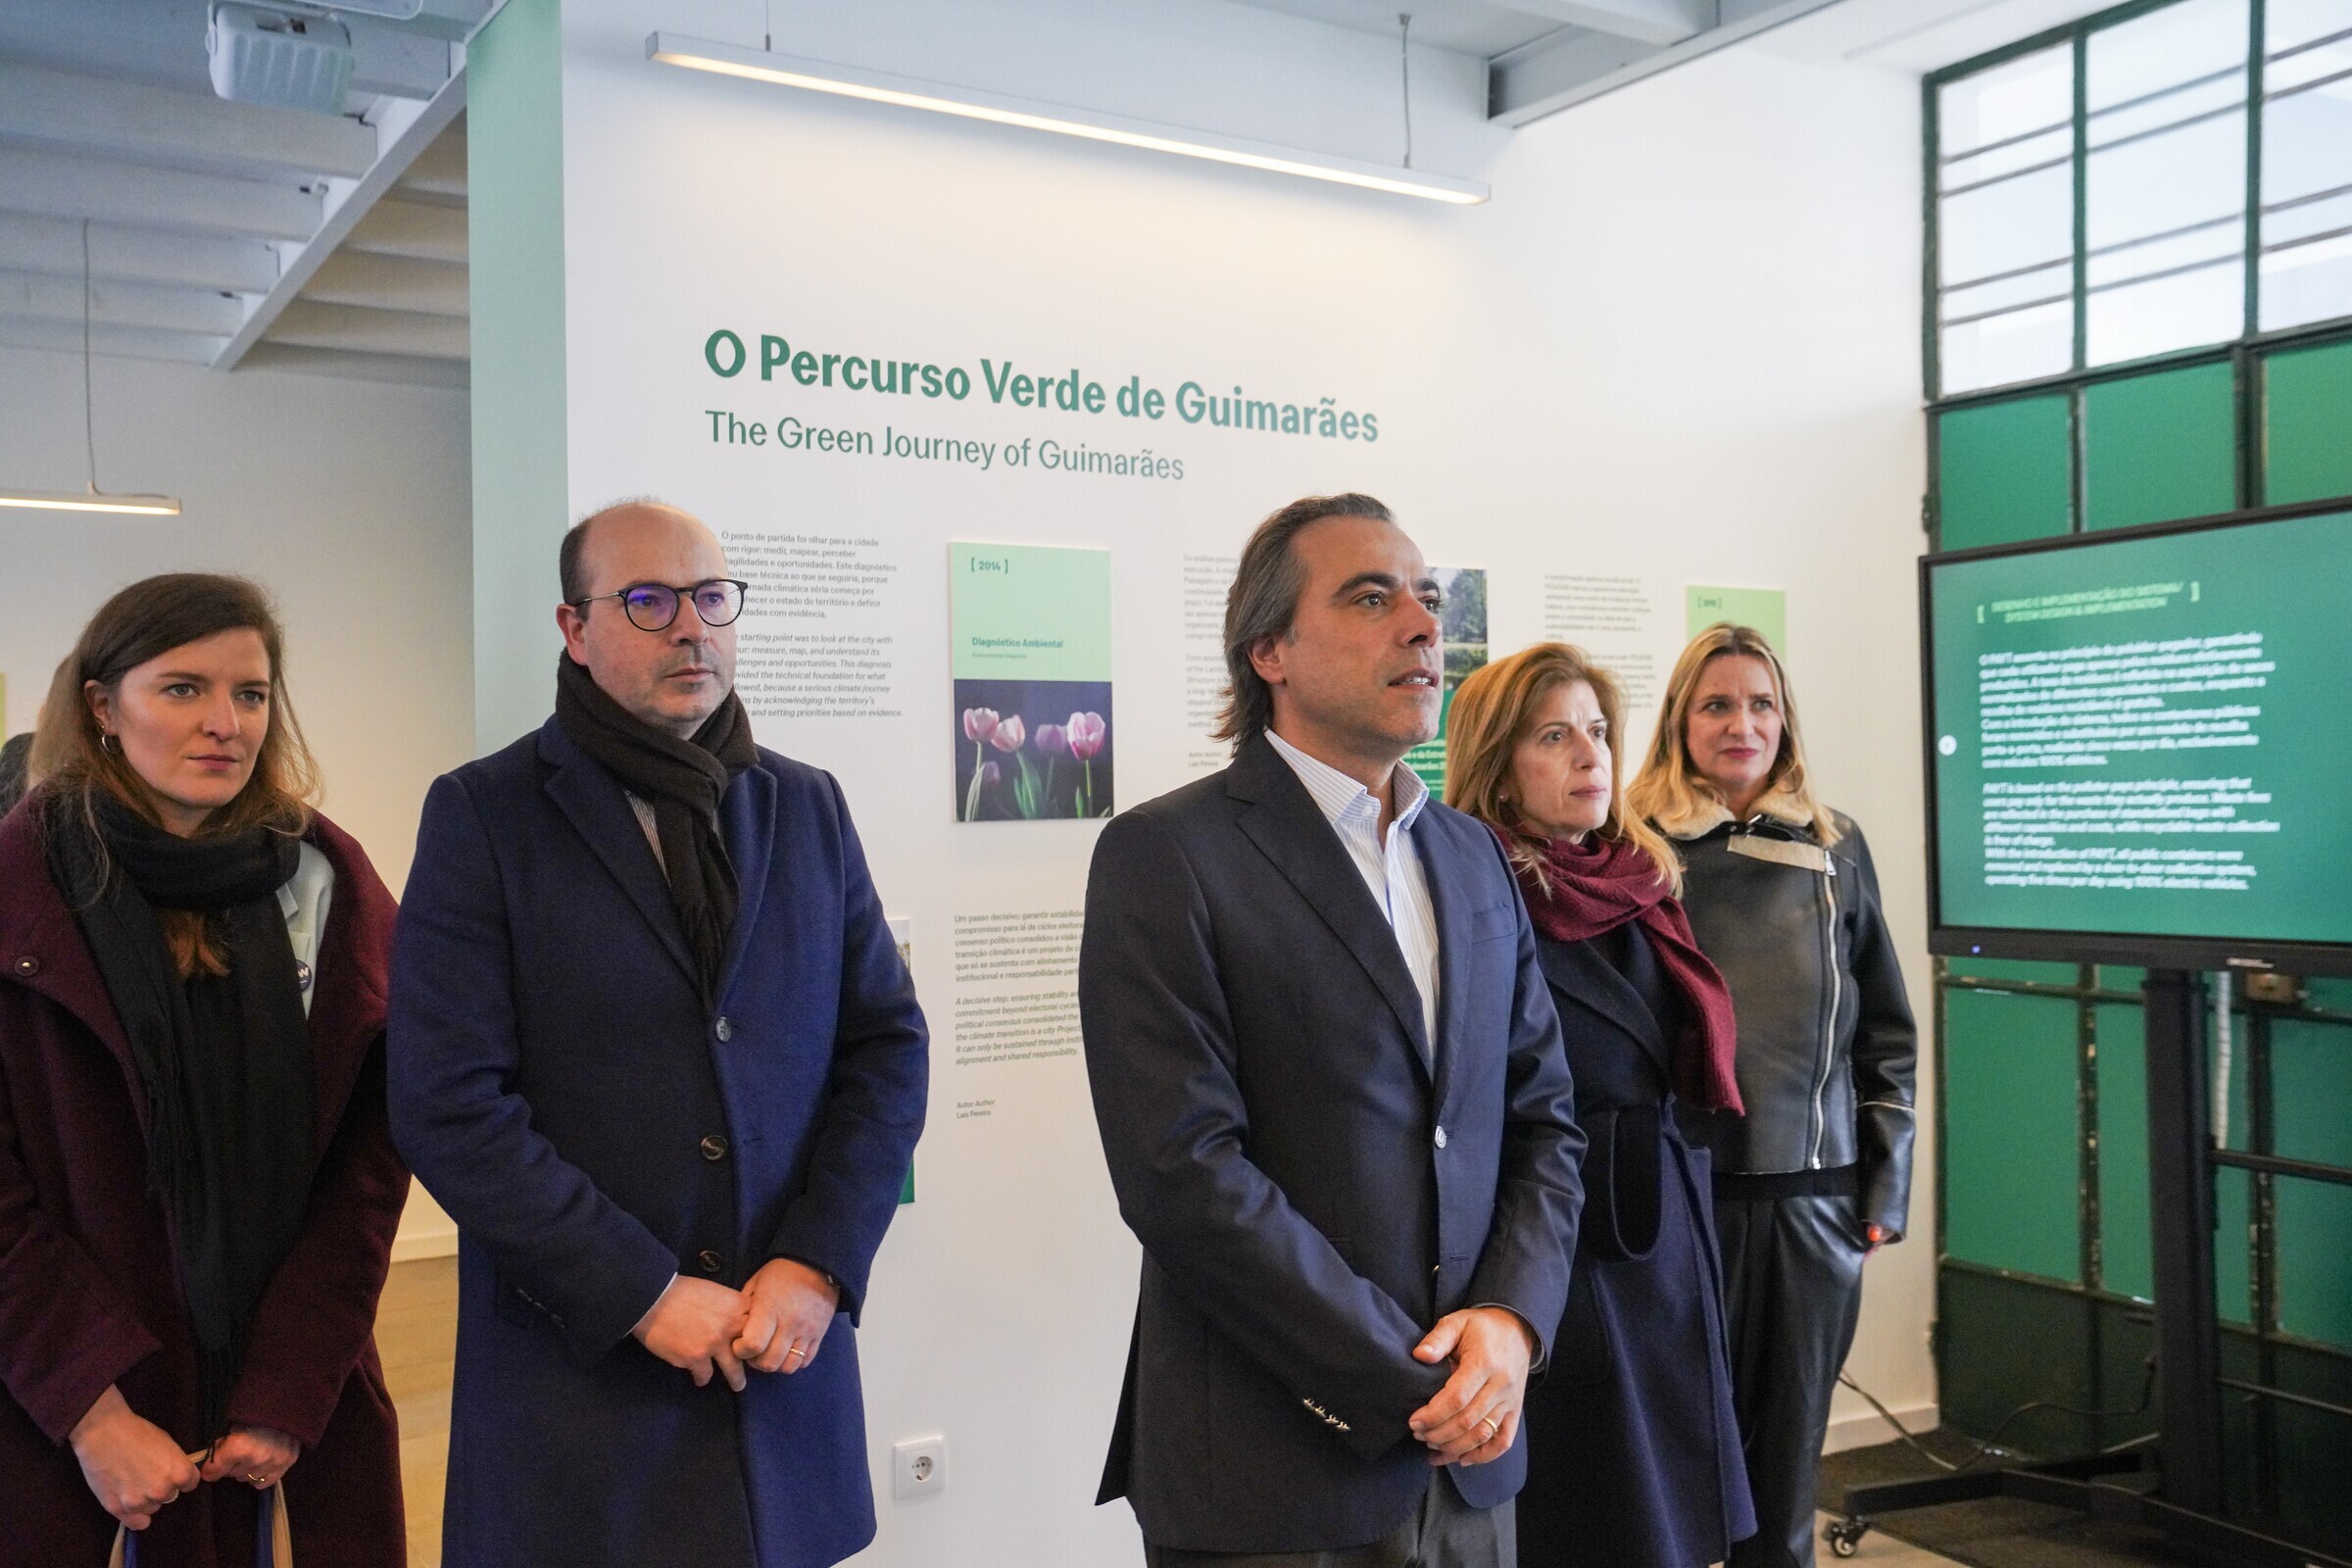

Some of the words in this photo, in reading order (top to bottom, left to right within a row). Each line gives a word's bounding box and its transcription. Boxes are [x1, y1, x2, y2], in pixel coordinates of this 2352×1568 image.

[705, 329, 747, 378] O
[760, 333, 971, 401] Percurso
[980, 357, 1106, 415] Verde
[1116, 374, 1165, 419] de
[1175, 380, 1379, 443] Guimarães
[705, 410, 767, 446] The
[777, 416, 874, 454] Green
[882, 425, 996, 470] Journey
[1004, 438, 1031, 466] of
[1039, 439, 1185, 480] Guimarães
[767, 533, 795, 543] partida
[797, 534, 807, 543] foi
[808, 535, 827, 544] olhar
[854, 538, 879, 547] cidade
[822, 549, 857, 558] perceber
[836, 561, 853, 570] Este
[854, 562, 898, 572] diagnóstico
[978, 561, 1002, 571] 2014
[739, 569, 759, 579] base
[760, 570, 789, 580] técnica
[861, 575, 888, 584] porque
[773, 583, 808, 593] climática
[810, 585, 829, 594] séria
[830, 586, 860, 596] começa
[861, 587, 874, 596] por
[775, 597, 803, 606] estado
[804, 597, 814, 606] do
[815, 597, 849, 607] território
[857, 599, 881, 608] definir
[740, 633, 771, 643] starting
[771, 633, 794, 643] point
[838, 635, 847, 644] at
[847, 635, 859, 644] the
[861, 636, 875, 645] city
[971, 636, 1021, 649] Diagnóstico
[1022, 638, 1063, 648] Ambiental
[809, 647, 825, 656] and
[768, 659, 784, 667] and
[840, 659, 856, 668] This
[857, 660, 892, 669] diagnosis
[775, 671, 811, 680] technical
[812, 671, 854, 680] foundation
[866, 672, 886, 681] what
[763, 683, 797, 692] because
[833, 684, 861, 693] climate
[861, 685, 891, 694] journey
[753, 696, 762, 705] by
[763, 696, 822, 706] acknowledging
[767, 709, 795, 718] setting
[796, 709, 831, 717] priorities
[832, 709, 856, 717] based
[968, 913, 989, 924] passo
[1021, 910, 1050, 920] garantir
[955, 925, 1002, 936] compromisso
[1003, 924, 1019, 933] para
[955, 938, 989, 947] consenso
[990, 936, 1015, 946] político
[1016, 934, 1054, 944] consolidou
[1060, 932, 1078, 941] visão
[955, 949, 988, 958] transição
[989, 947, 1020, 956] climática
[1040, 945, 1064, 956] projeto
[956, 962, 969, 972] que
[989, 958, 1019, 968] sustenta
[1020, 957, 1035, 966] com
[956, 971, 999, 982] institucional
[1005, 967, 1063, 980] responsabilidade
[961, 997, 991, 1005] decisive
[1010, 993, 1042, 1003] ensuring
[1042, 990, 1068, 1000] stability
[955, 1007, 1001, 1018] commitment
[1002, 1005, 1028, 1015] beyond
[955, 1019, 984, 1031] political
[985, 1018, 1021, 1028] consensus
[1022, 1014, 1066, 1025] consolidated
[969, 1030, 995, 1040] climate
[996, 1028, 1030, 1039] transition
[962, 1044, 976, 1053] can
[976, 1042, 993, 1053] only
[1003, 1039, 1037, 1050] sustained
[1038, 1037, 1065, 1048] through
[956, 1055, 993, 1065] alignment
[1007, 1052, 1032, 1060] shared
